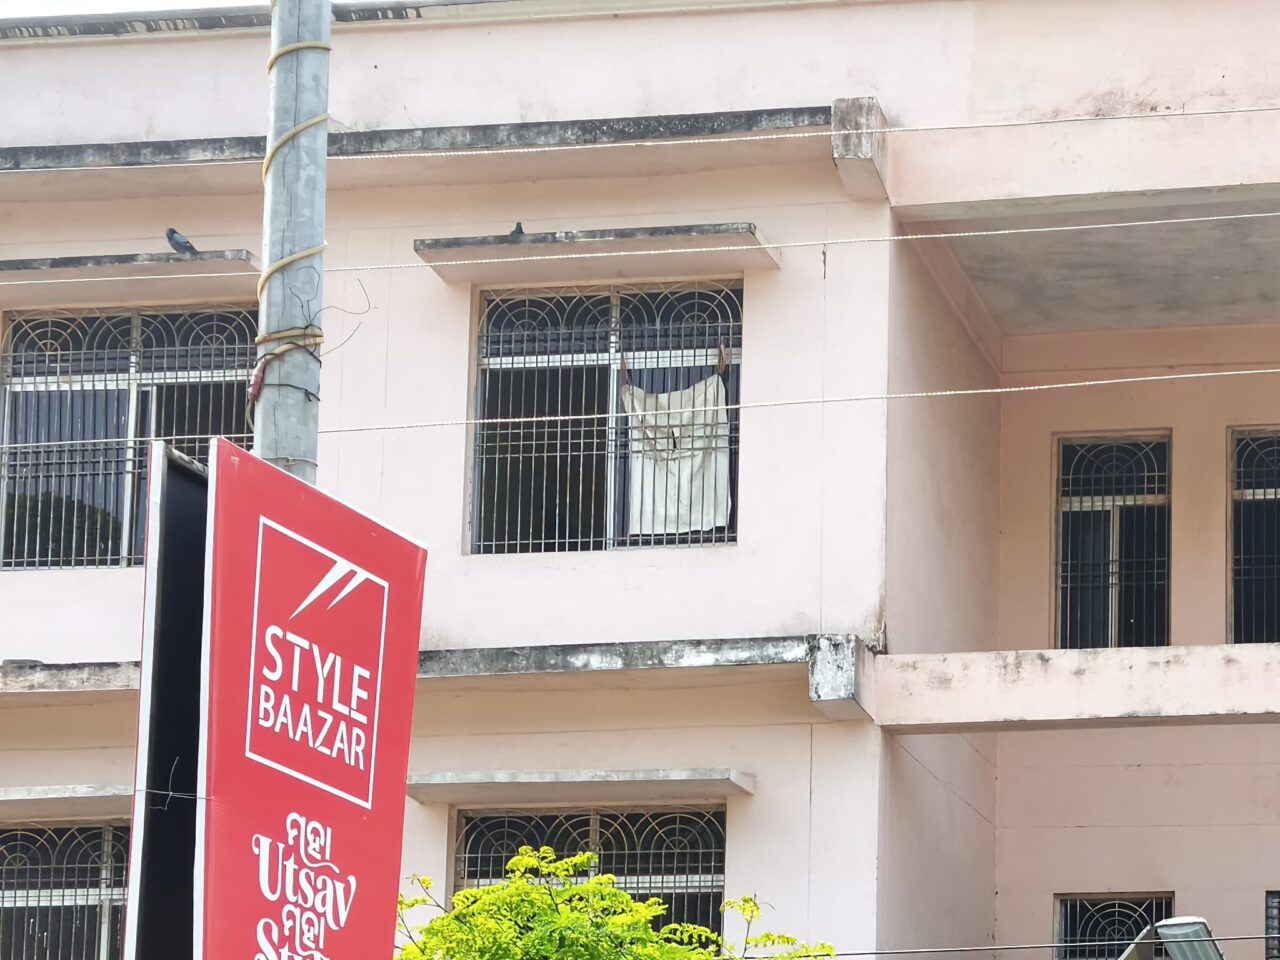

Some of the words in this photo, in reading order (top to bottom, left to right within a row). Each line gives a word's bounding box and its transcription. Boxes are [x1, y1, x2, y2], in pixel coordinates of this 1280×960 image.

[262, 625, 371, 725] STYLE
[258, 684, 366, 771] BAAZAR
[252, 833, 357, 931] Utsav
[285, 811, 340, 874] ମହା
